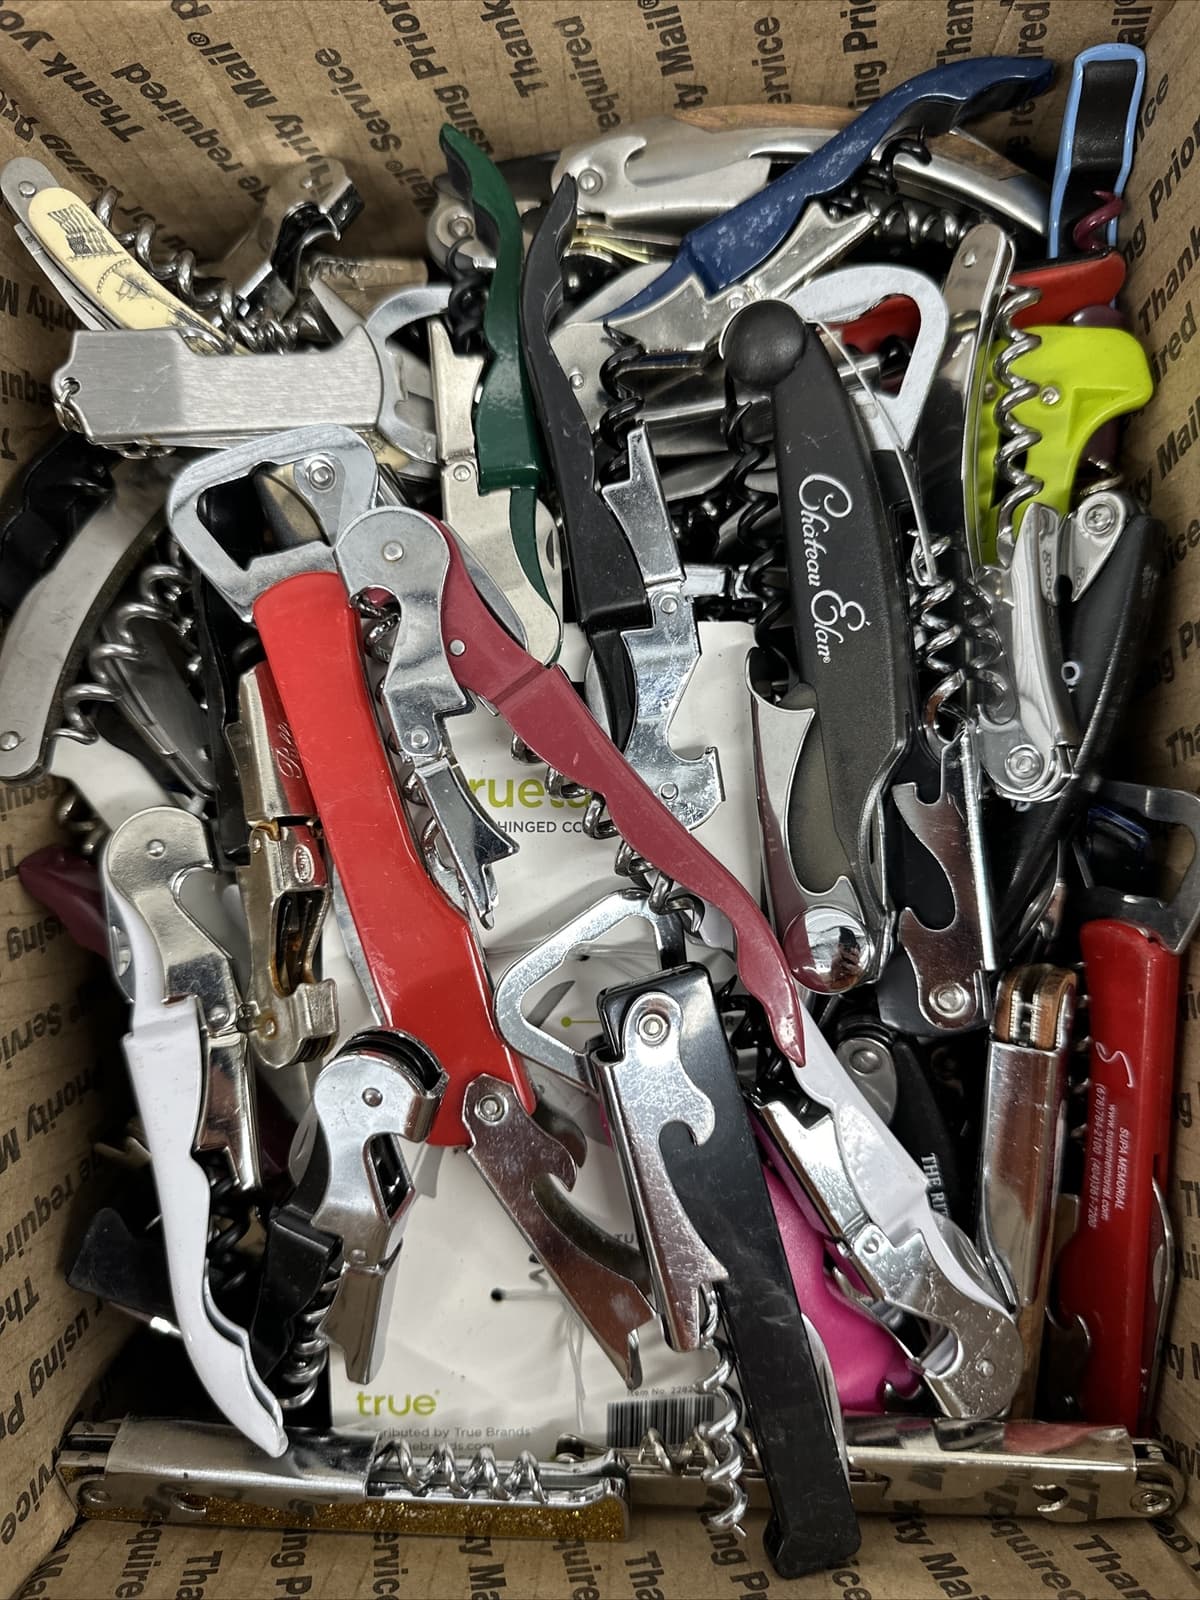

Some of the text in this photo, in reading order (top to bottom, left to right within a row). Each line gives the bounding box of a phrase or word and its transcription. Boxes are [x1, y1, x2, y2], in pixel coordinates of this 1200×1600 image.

[0, 10, 54, 51] yo
[480, 0, 548, 98] Thank
[553, 15, 622, 131] equired
[40, 52, 144, 143] Thank
[111, 62, 243, 173] required
[314, 48, 402, 152] Service
[29, 1307, 90, 1398] using
[434, 1427, 450, 1440] by
[454, 1426, 482, 1438] True
